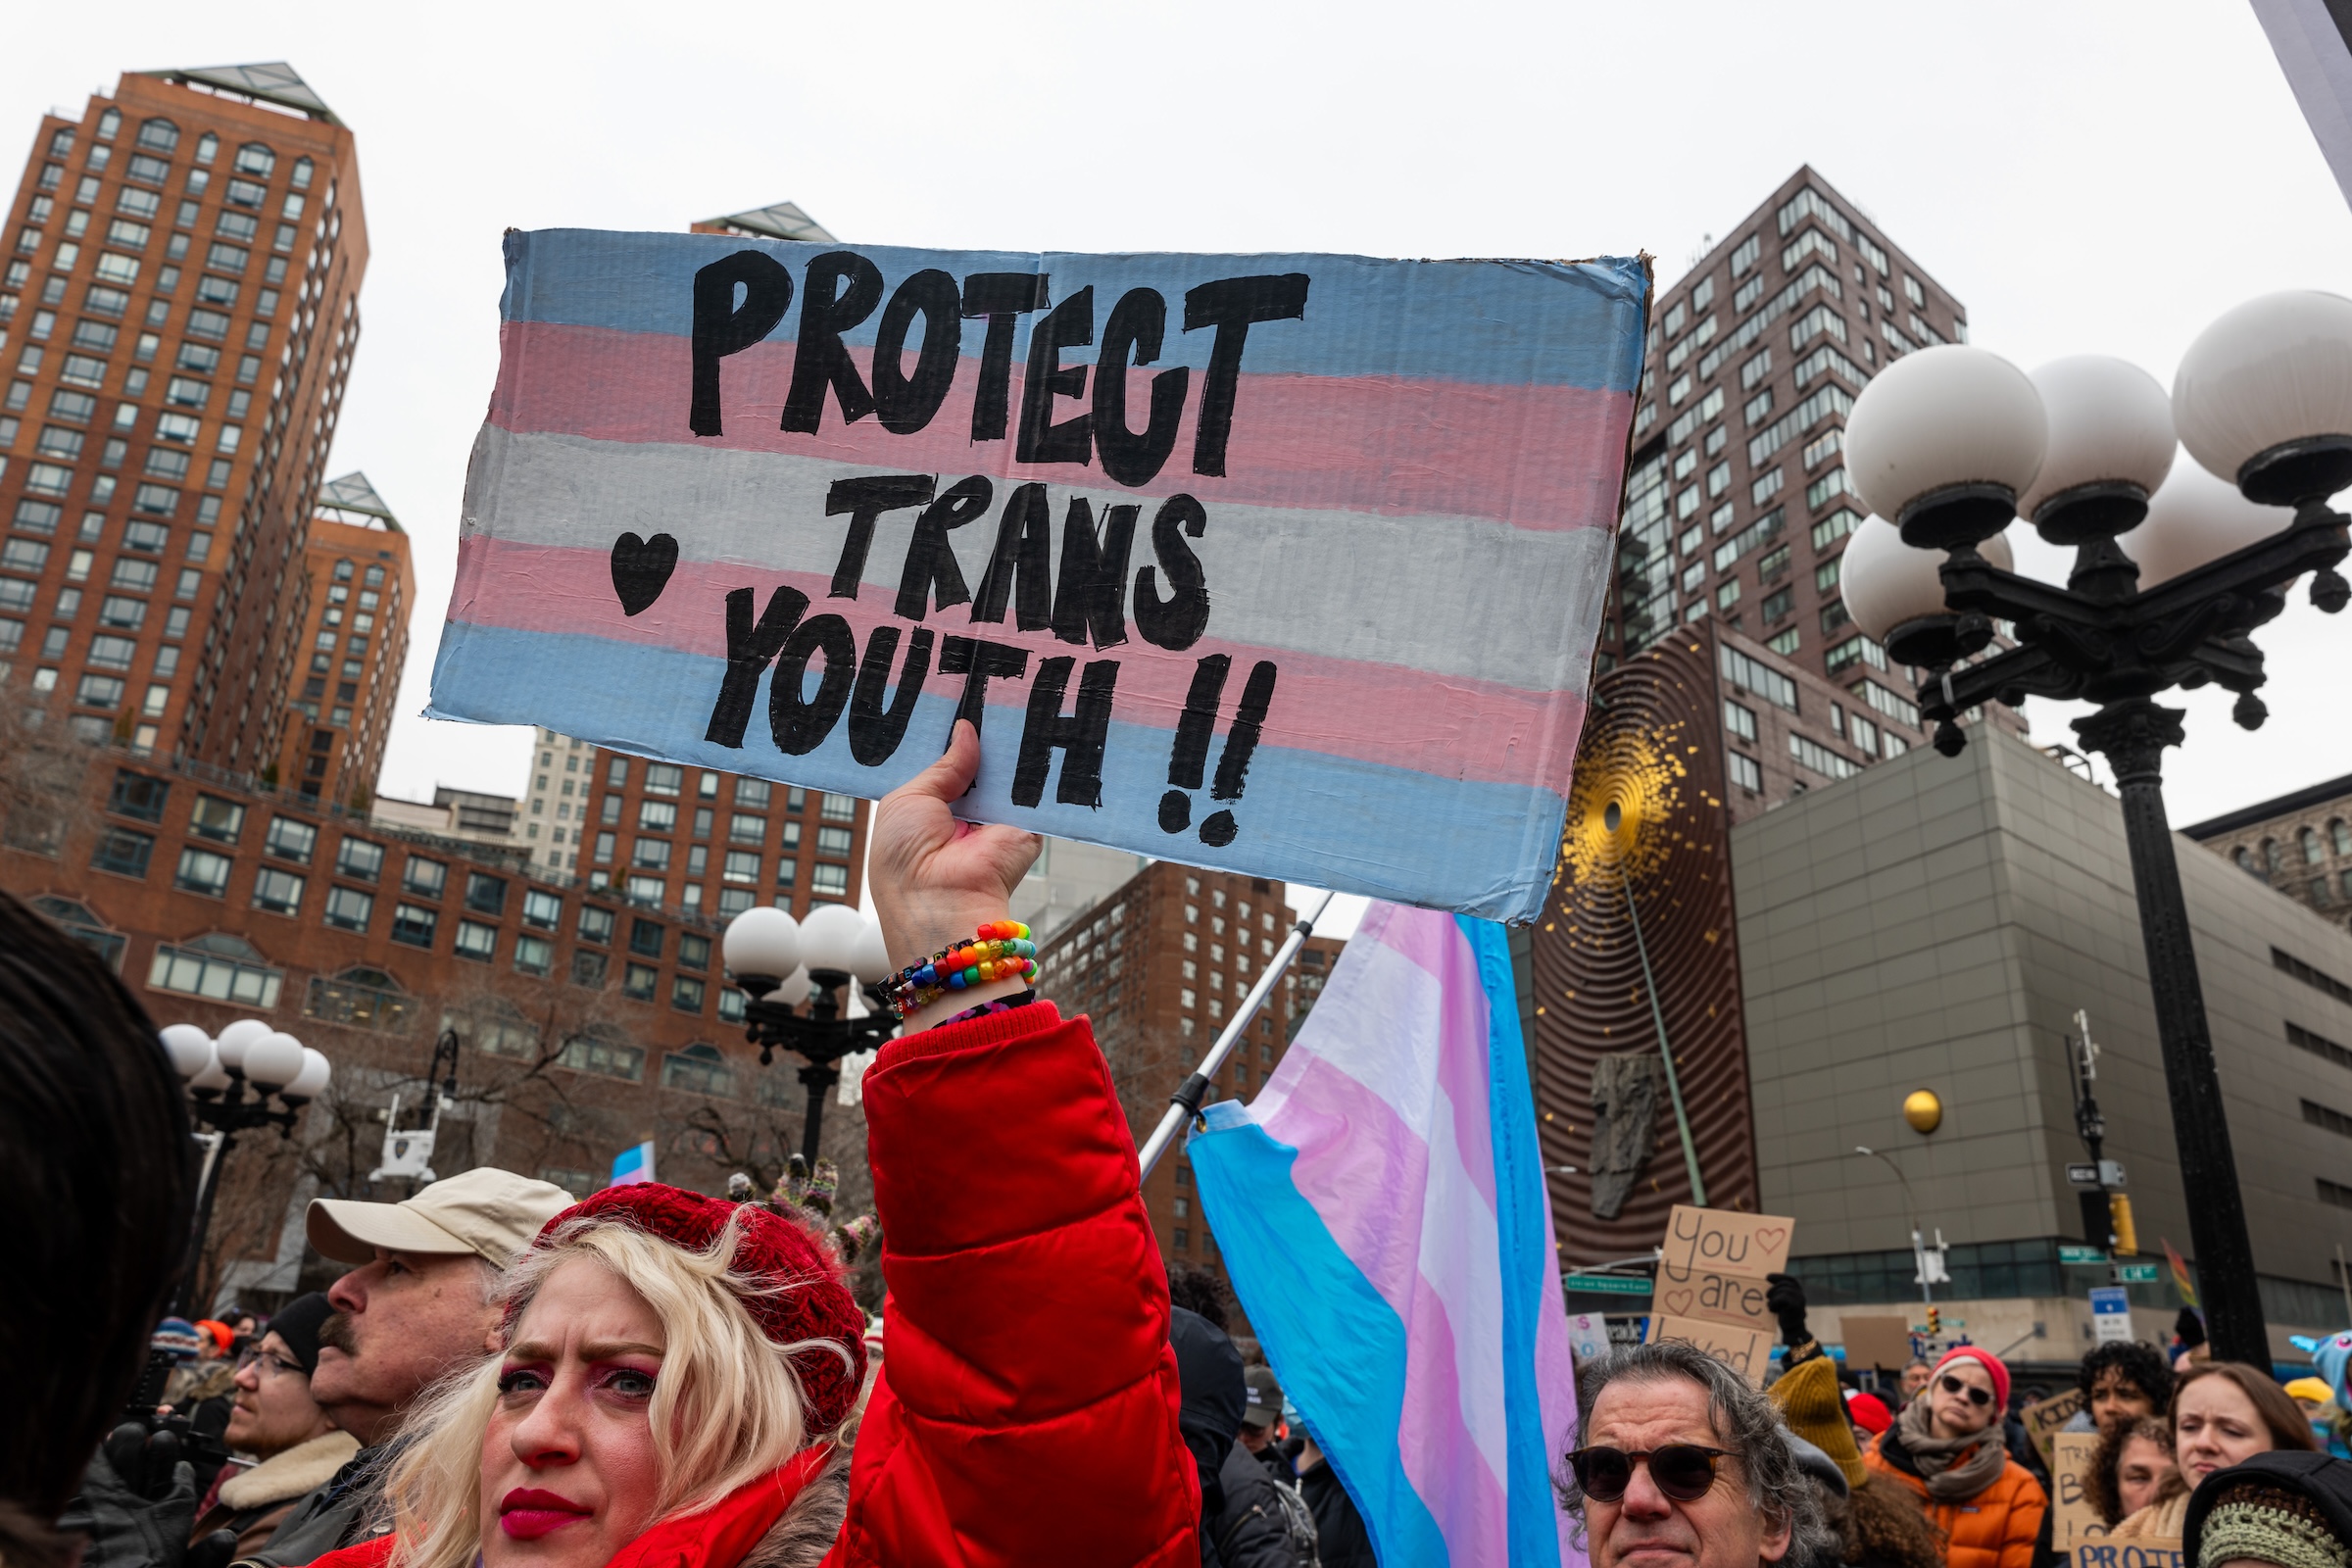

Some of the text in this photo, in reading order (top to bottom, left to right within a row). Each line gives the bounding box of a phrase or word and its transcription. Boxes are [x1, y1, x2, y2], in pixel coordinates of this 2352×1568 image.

[690, 250, 1309, 487] PROTECT
[826, 474, 1209, 651] TRANS
[705, 585, 1119, 810] YOUTH
[1699, 1275, 1764, 1316] are
[2079, 1544, 2184, 1568] PROTE
